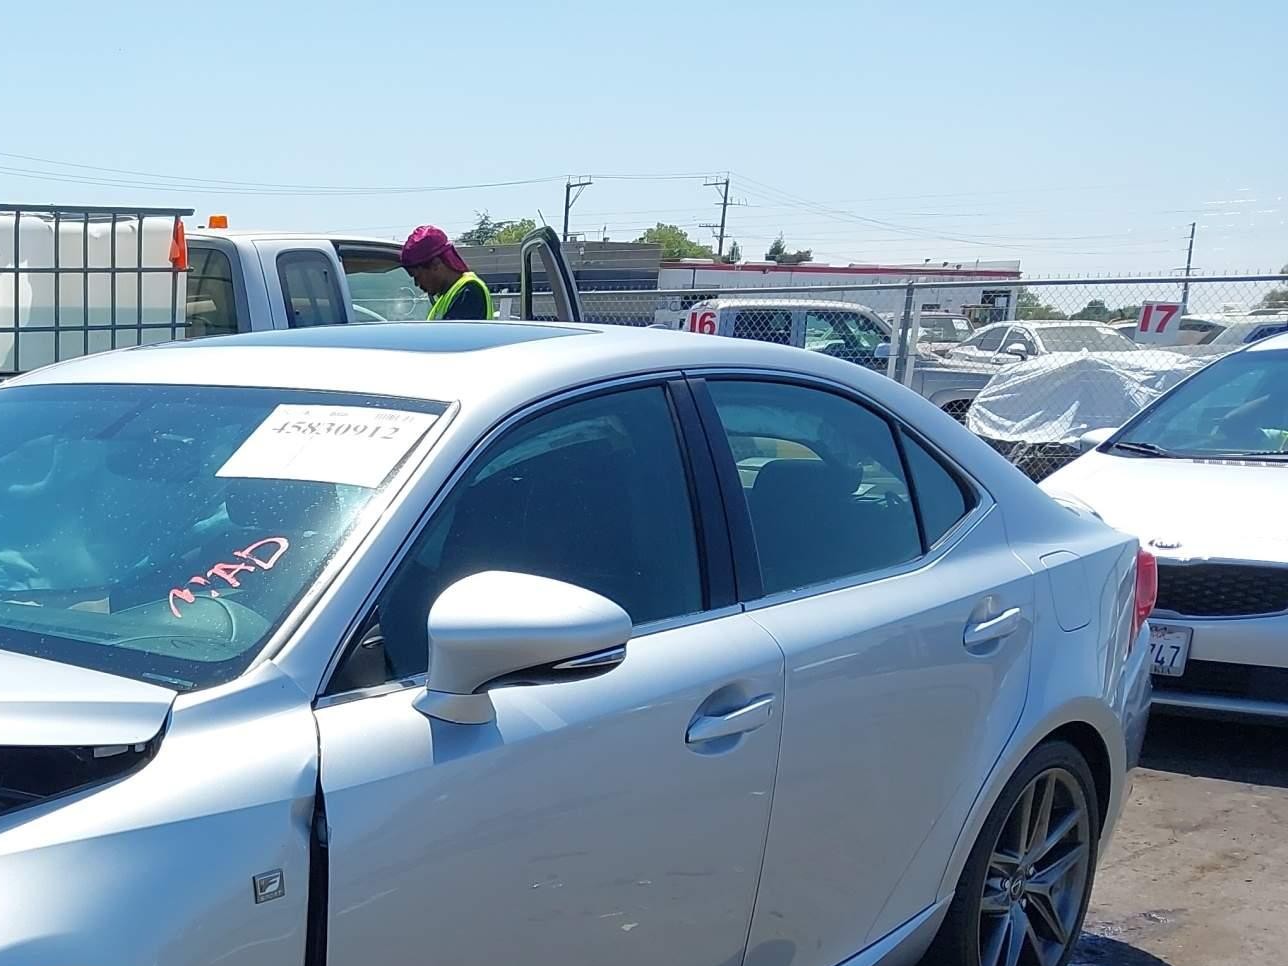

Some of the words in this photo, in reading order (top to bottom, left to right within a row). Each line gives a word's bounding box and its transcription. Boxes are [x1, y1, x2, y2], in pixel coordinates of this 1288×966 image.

[689, 310, 717, 335] 16
[1139, 304, 1180, 333] 17
[272, 421, 401, 440] 45830912
